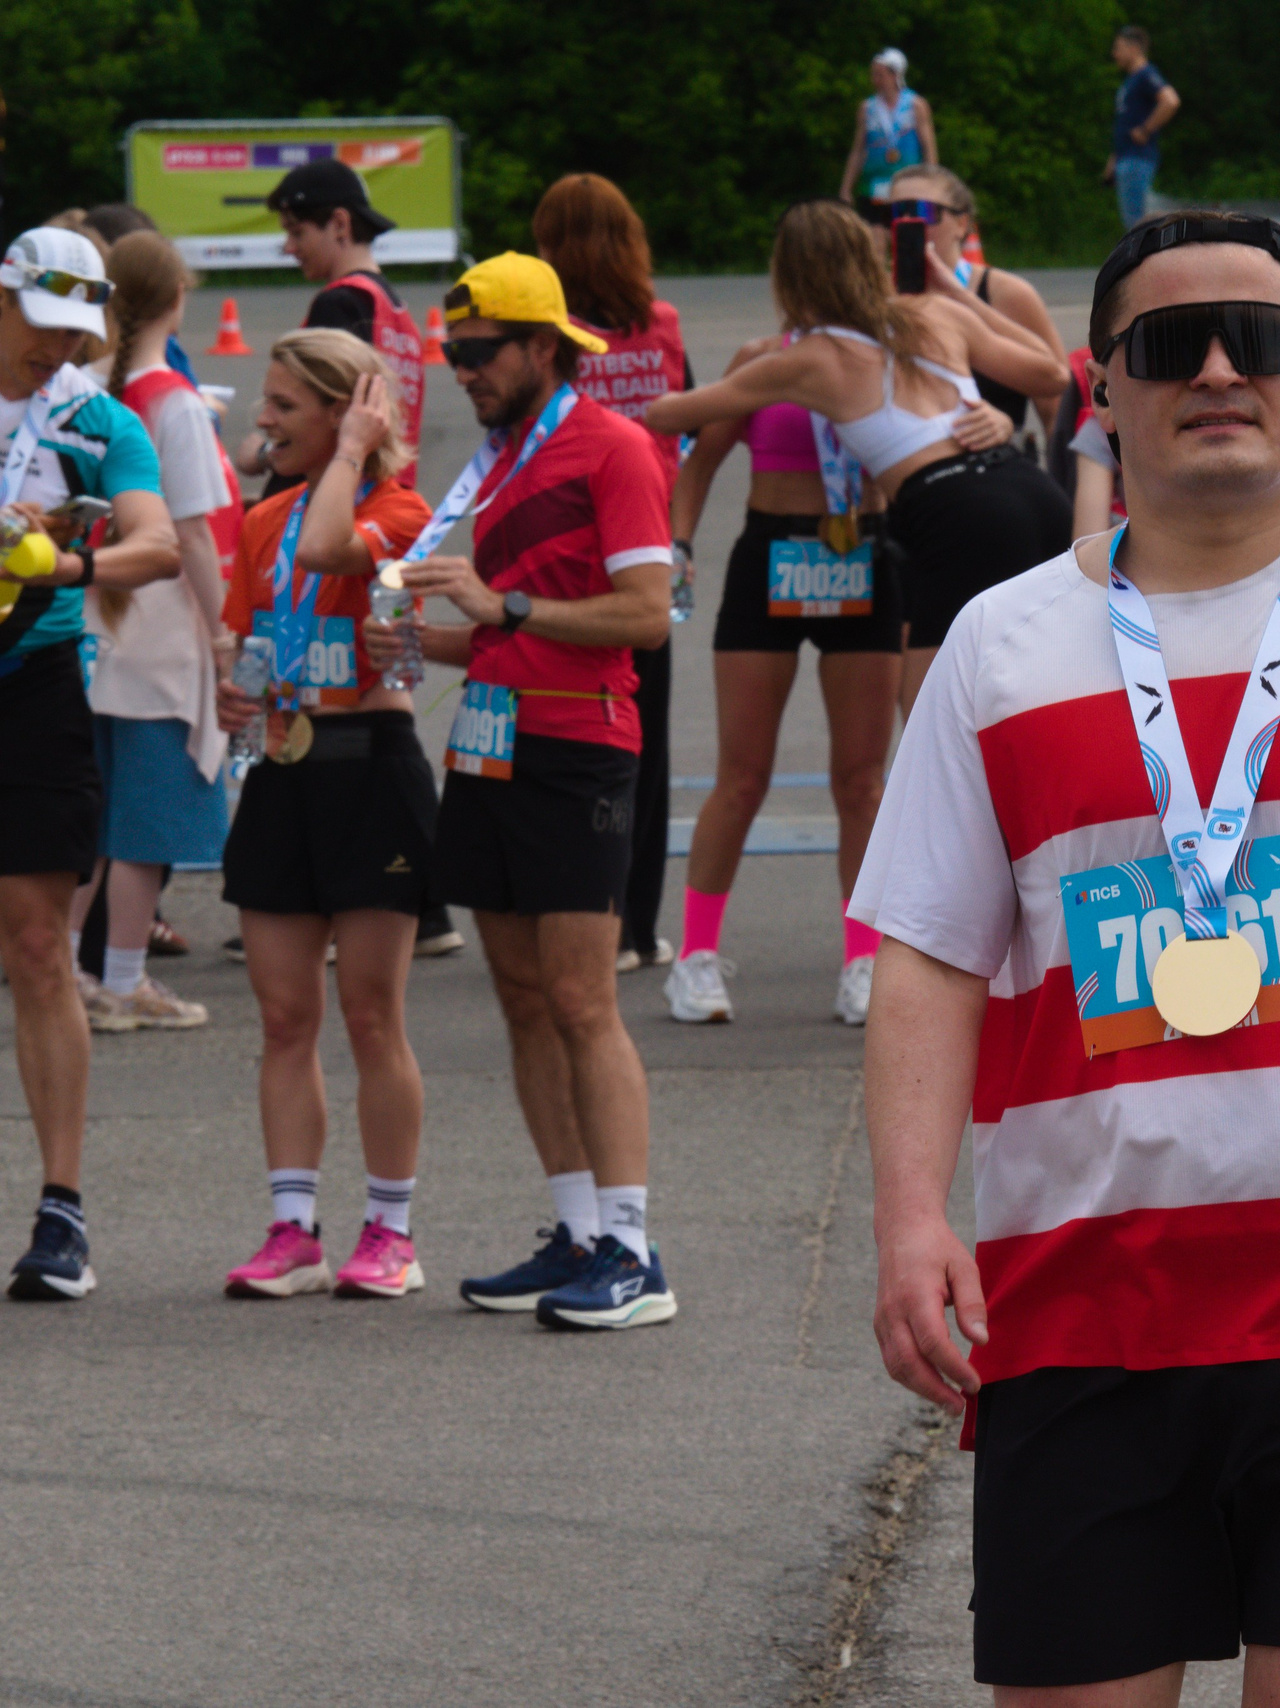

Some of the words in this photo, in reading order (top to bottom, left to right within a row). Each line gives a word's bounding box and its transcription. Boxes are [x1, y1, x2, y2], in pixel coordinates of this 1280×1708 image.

[612, 374, 669, 399] ВАШ
[776, 562, 866, 597] 70020
[1090, 884, 1121, 902] ПСБ
